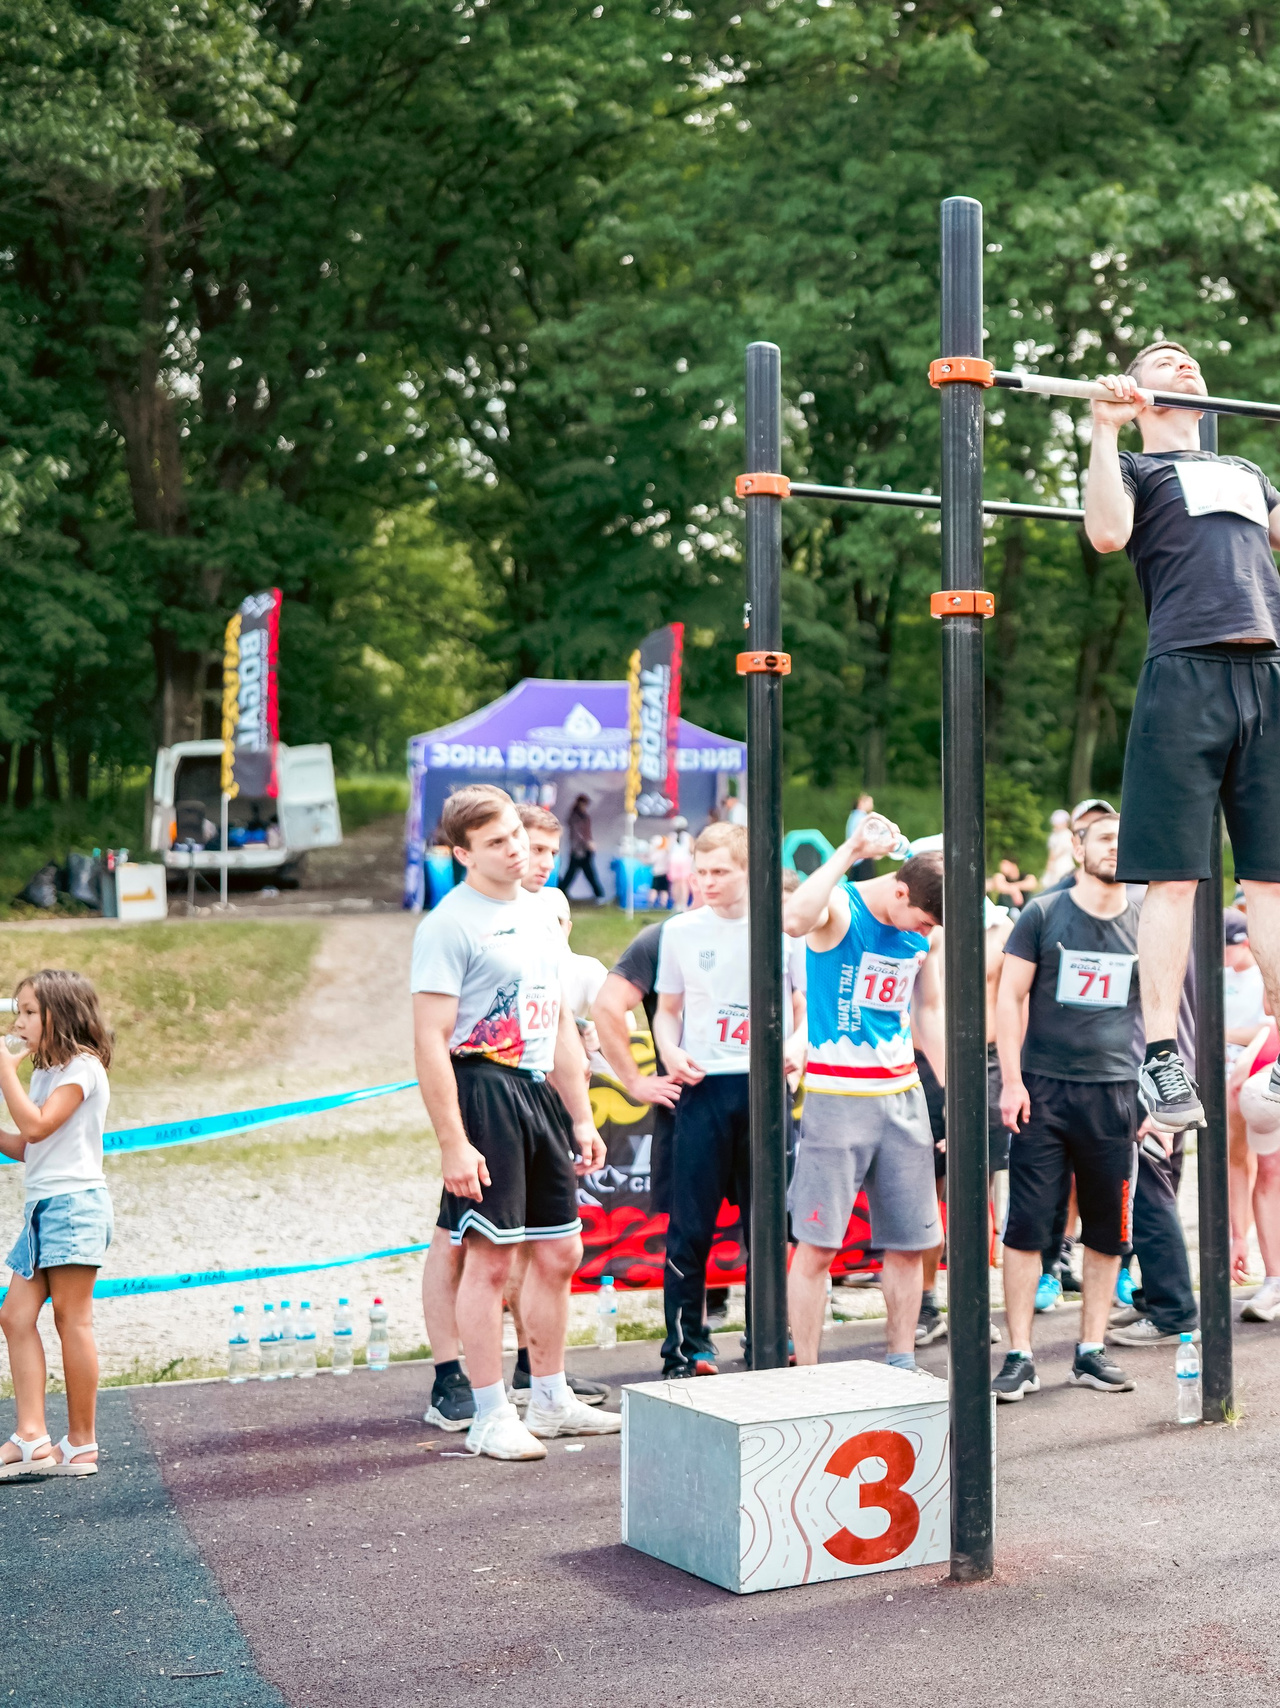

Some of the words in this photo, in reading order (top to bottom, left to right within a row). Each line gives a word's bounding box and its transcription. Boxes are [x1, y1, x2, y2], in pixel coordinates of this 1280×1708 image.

[640, 664, 663, 780] BOGAL
[431, 742, 506, 769] ЗОНА
[507, 746, 743, 771] ВОССТАНЕНИЯ
[838, 963, 854, 994] THAI
[867, 964, 899, 976] BOGAL
[1070, 962, 1102, 972] BOGAL
[864, 973, 909, 1003] 182
[1078, 970, 1111, 998] 71
[837, 997, 851, 1032] MUAY
[822, 1429, 920, 1565] 3
